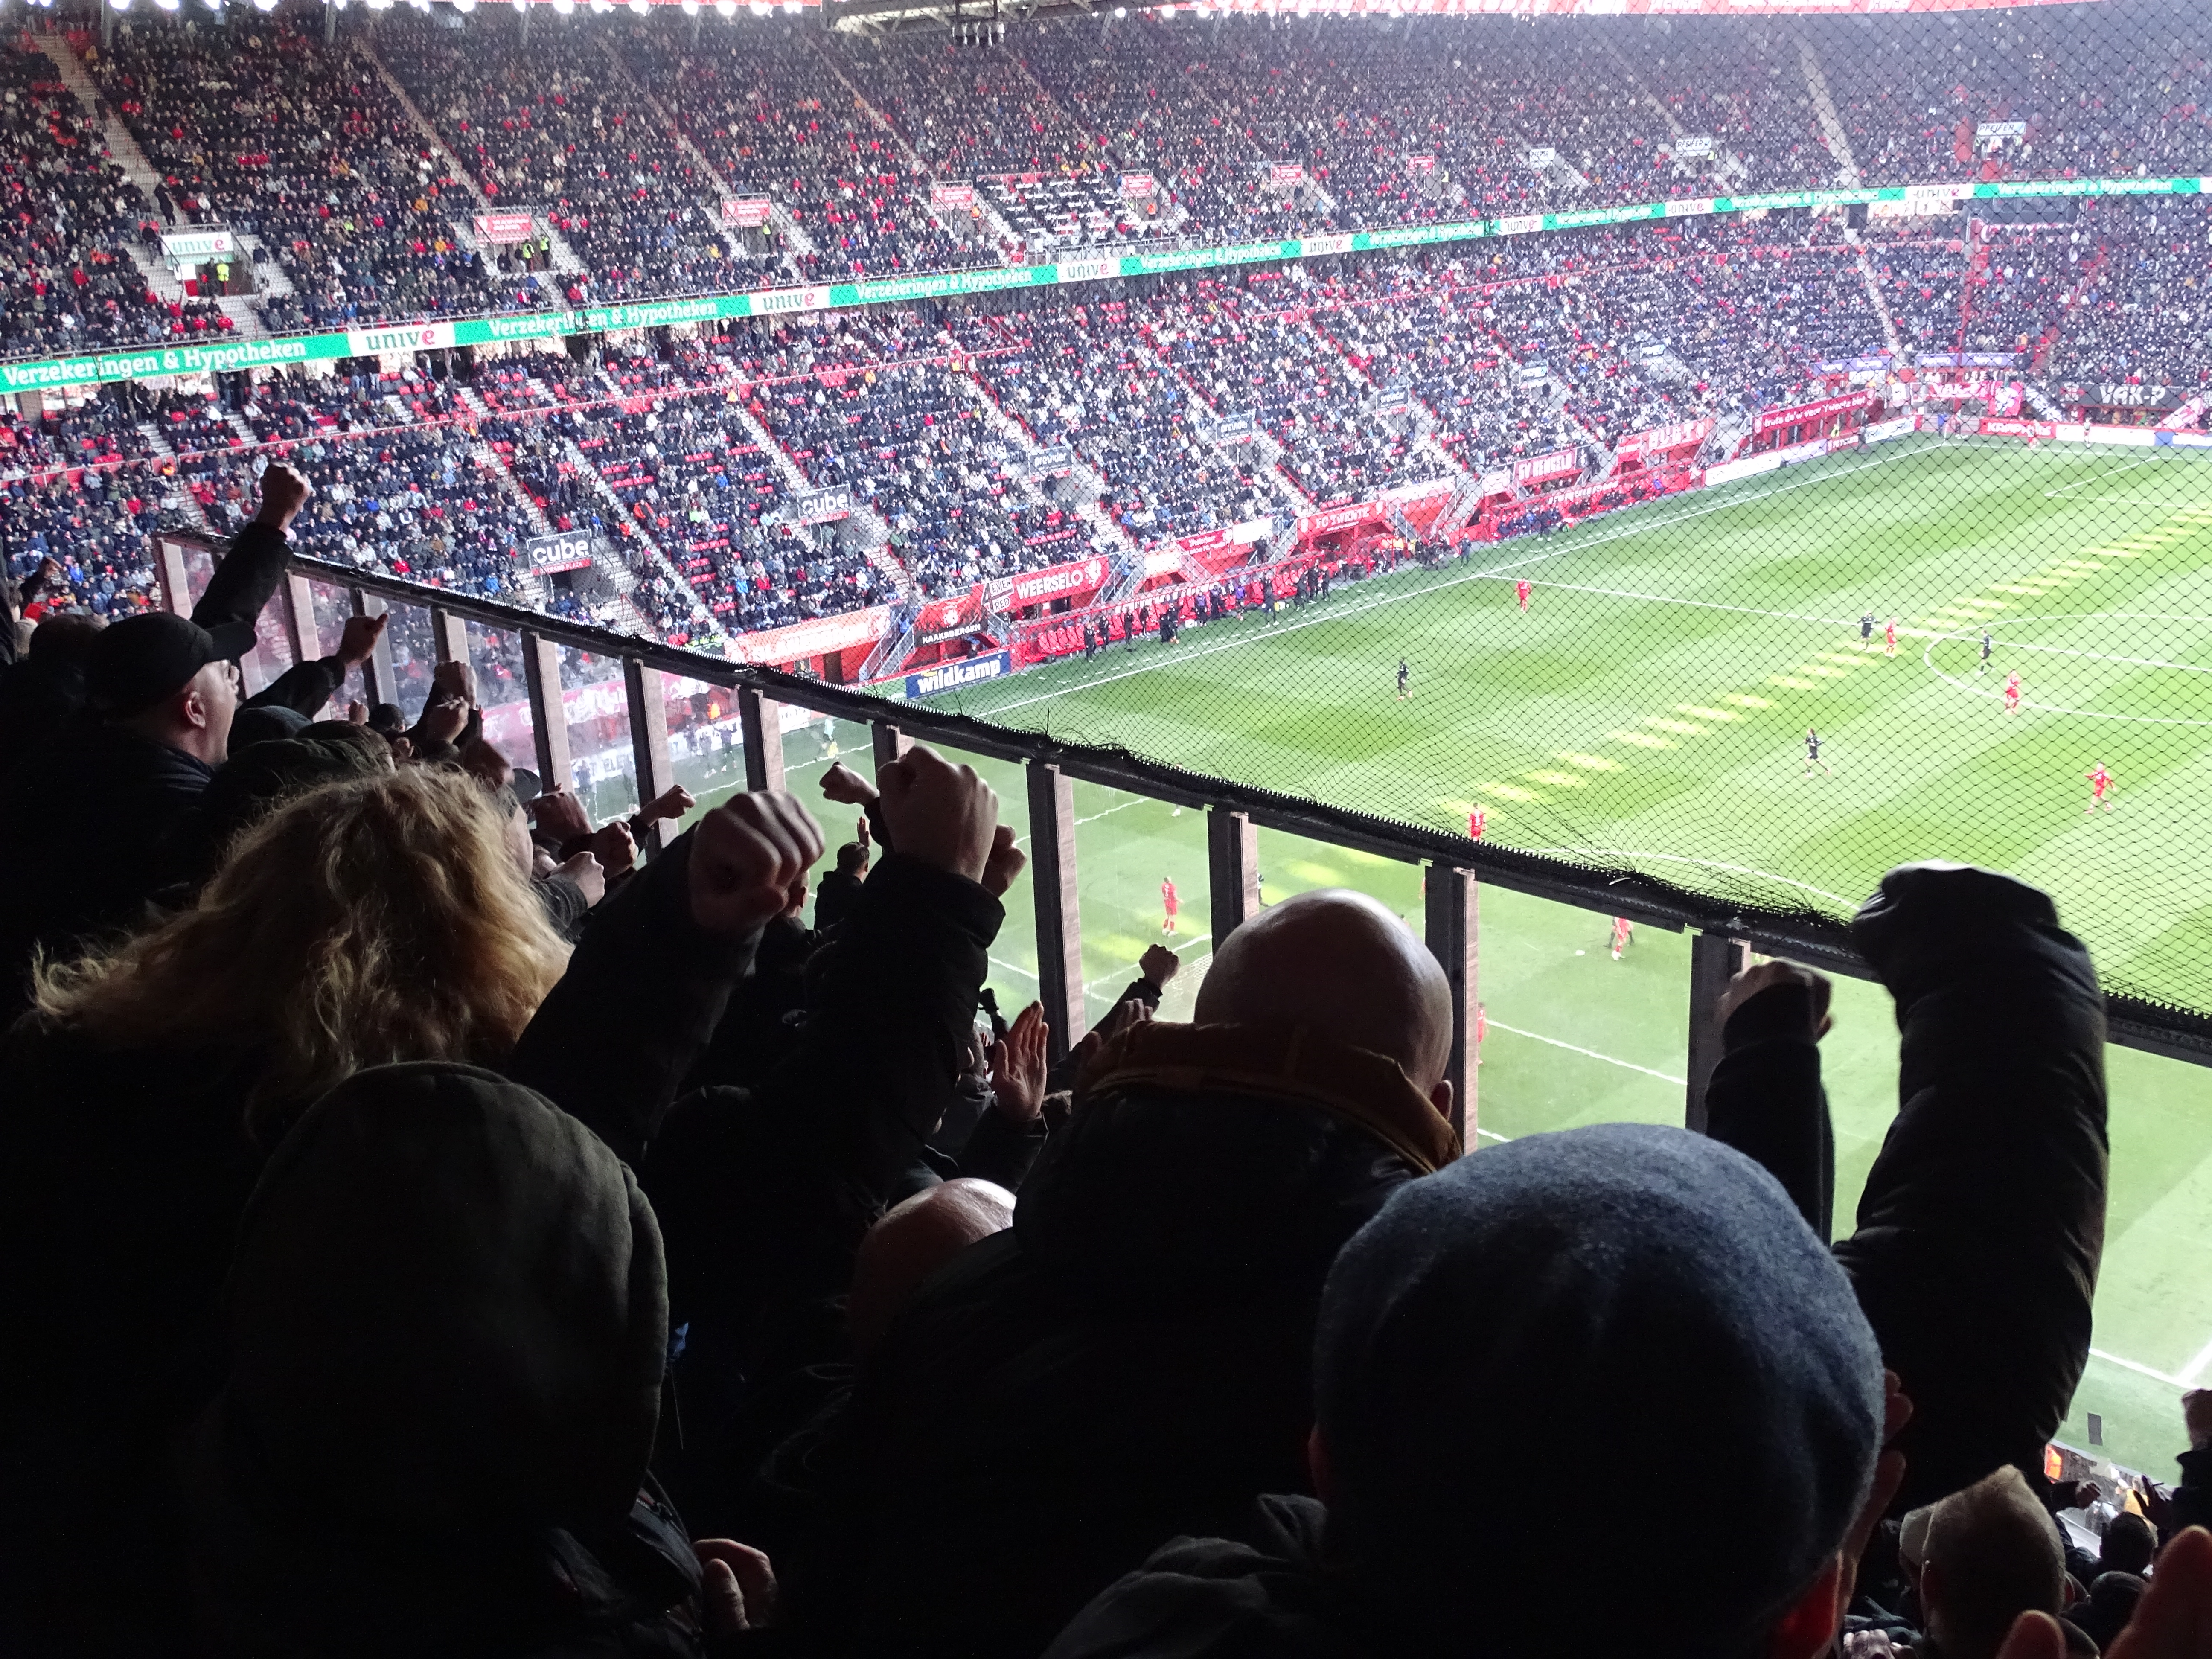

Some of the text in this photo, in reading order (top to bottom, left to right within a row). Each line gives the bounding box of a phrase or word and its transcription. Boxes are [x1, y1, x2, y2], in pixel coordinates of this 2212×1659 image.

[855, 278, 947, 299] Verzekeringen
[960, 269, 1033, 292] Hypotheken
[611, 308, 623, 325] &
[626, 300, 717, 326] Hypotheken
[2, 340, 306, 386] Verzekeringen & Hypotheken
[2099, 385, 2166, 406] VAK-P
[1034, 452, 1067, 468] previder
[1330, 507, 1369, 525] TWENTE
[566, 561, 583, 569] PLAZA
[991, 578, 1011, 593] EVER
[1016, 570, 1083, 600] WEERSELO
[995, 598, 1009, 610] RED
[922, 623, 981, 644] HAAKSBERGEN
[917, 659, 1001, 694] wildkamp
